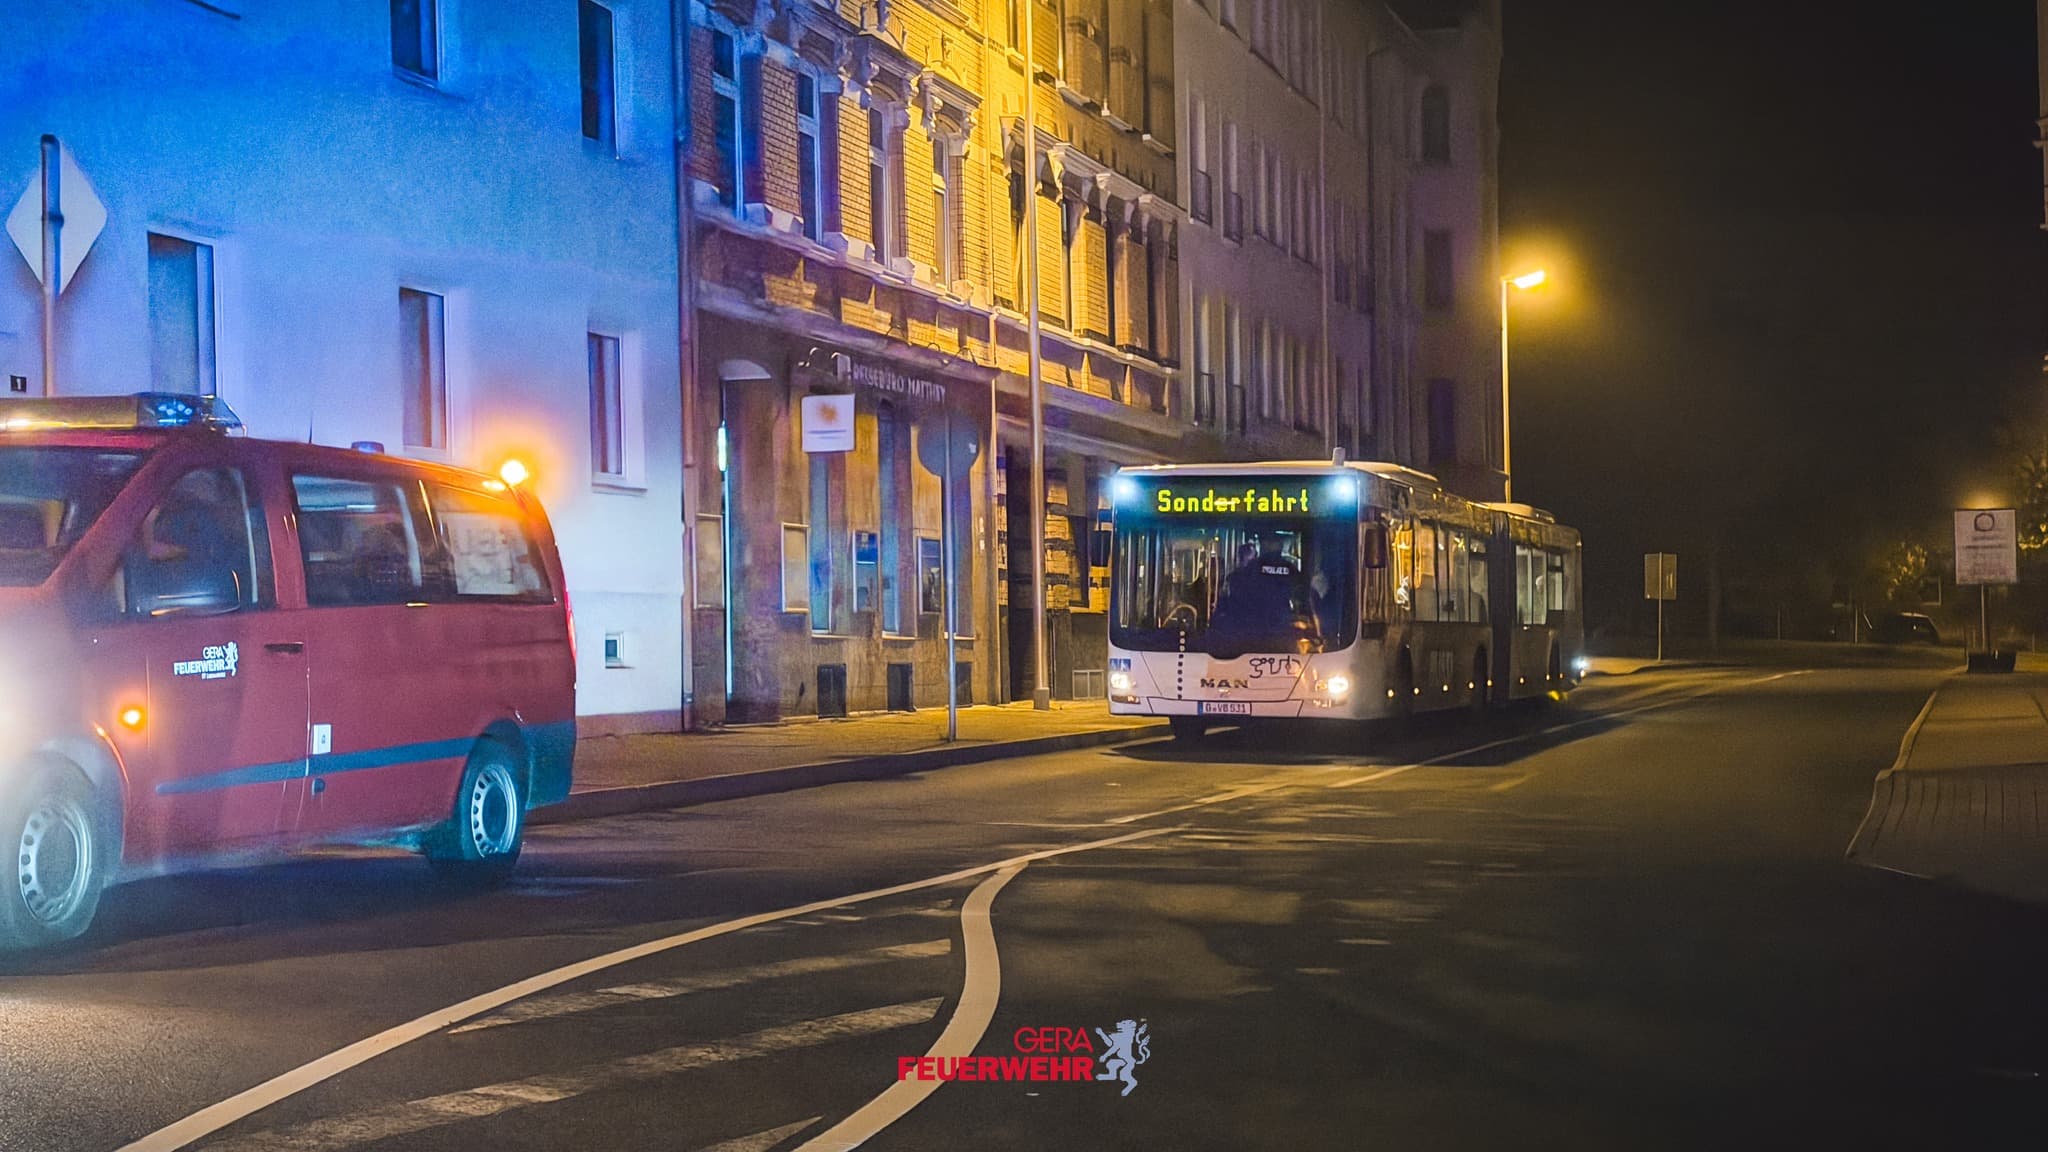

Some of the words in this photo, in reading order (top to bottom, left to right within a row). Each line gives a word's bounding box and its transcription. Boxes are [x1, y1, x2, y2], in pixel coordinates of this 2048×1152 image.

[1158, 489, 1309, 512] Sonderfahrt
[203, 646, 225, 659] GERA
[174, 659, 225, 676] FEUERWEHR
[1200, 678, 1248, 689] MAN
